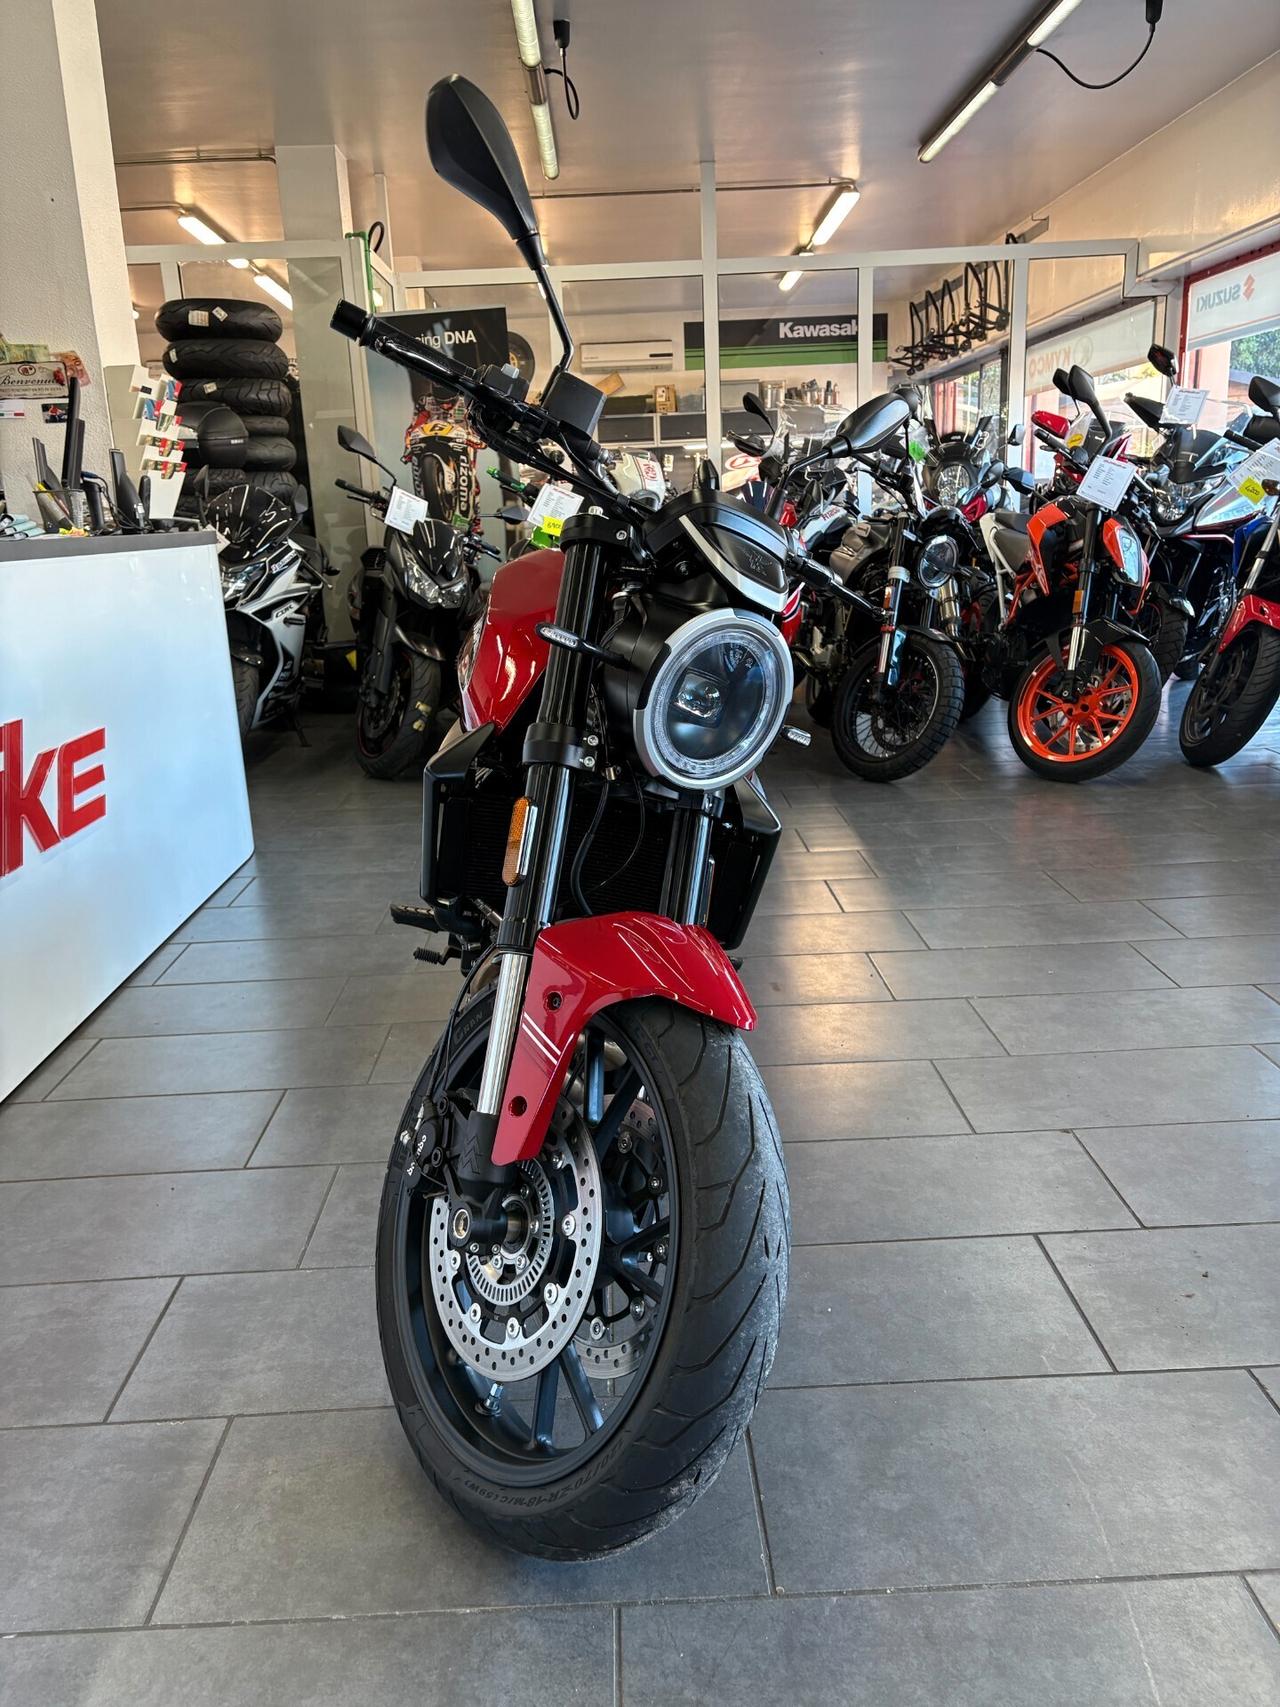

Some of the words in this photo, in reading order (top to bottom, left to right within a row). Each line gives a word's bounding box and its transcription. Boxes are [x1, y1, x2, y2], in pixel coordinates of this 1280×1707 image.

[415, 334, 441, 348] ing
[444, 329, 477, 345] DNA
[779, 319, 858, 339] Kawasak
[0, 374, 56, 386] Benvenu
[459, 455, 469, 512] rizoma
[407, 1134, 427, 1176] brmbo
